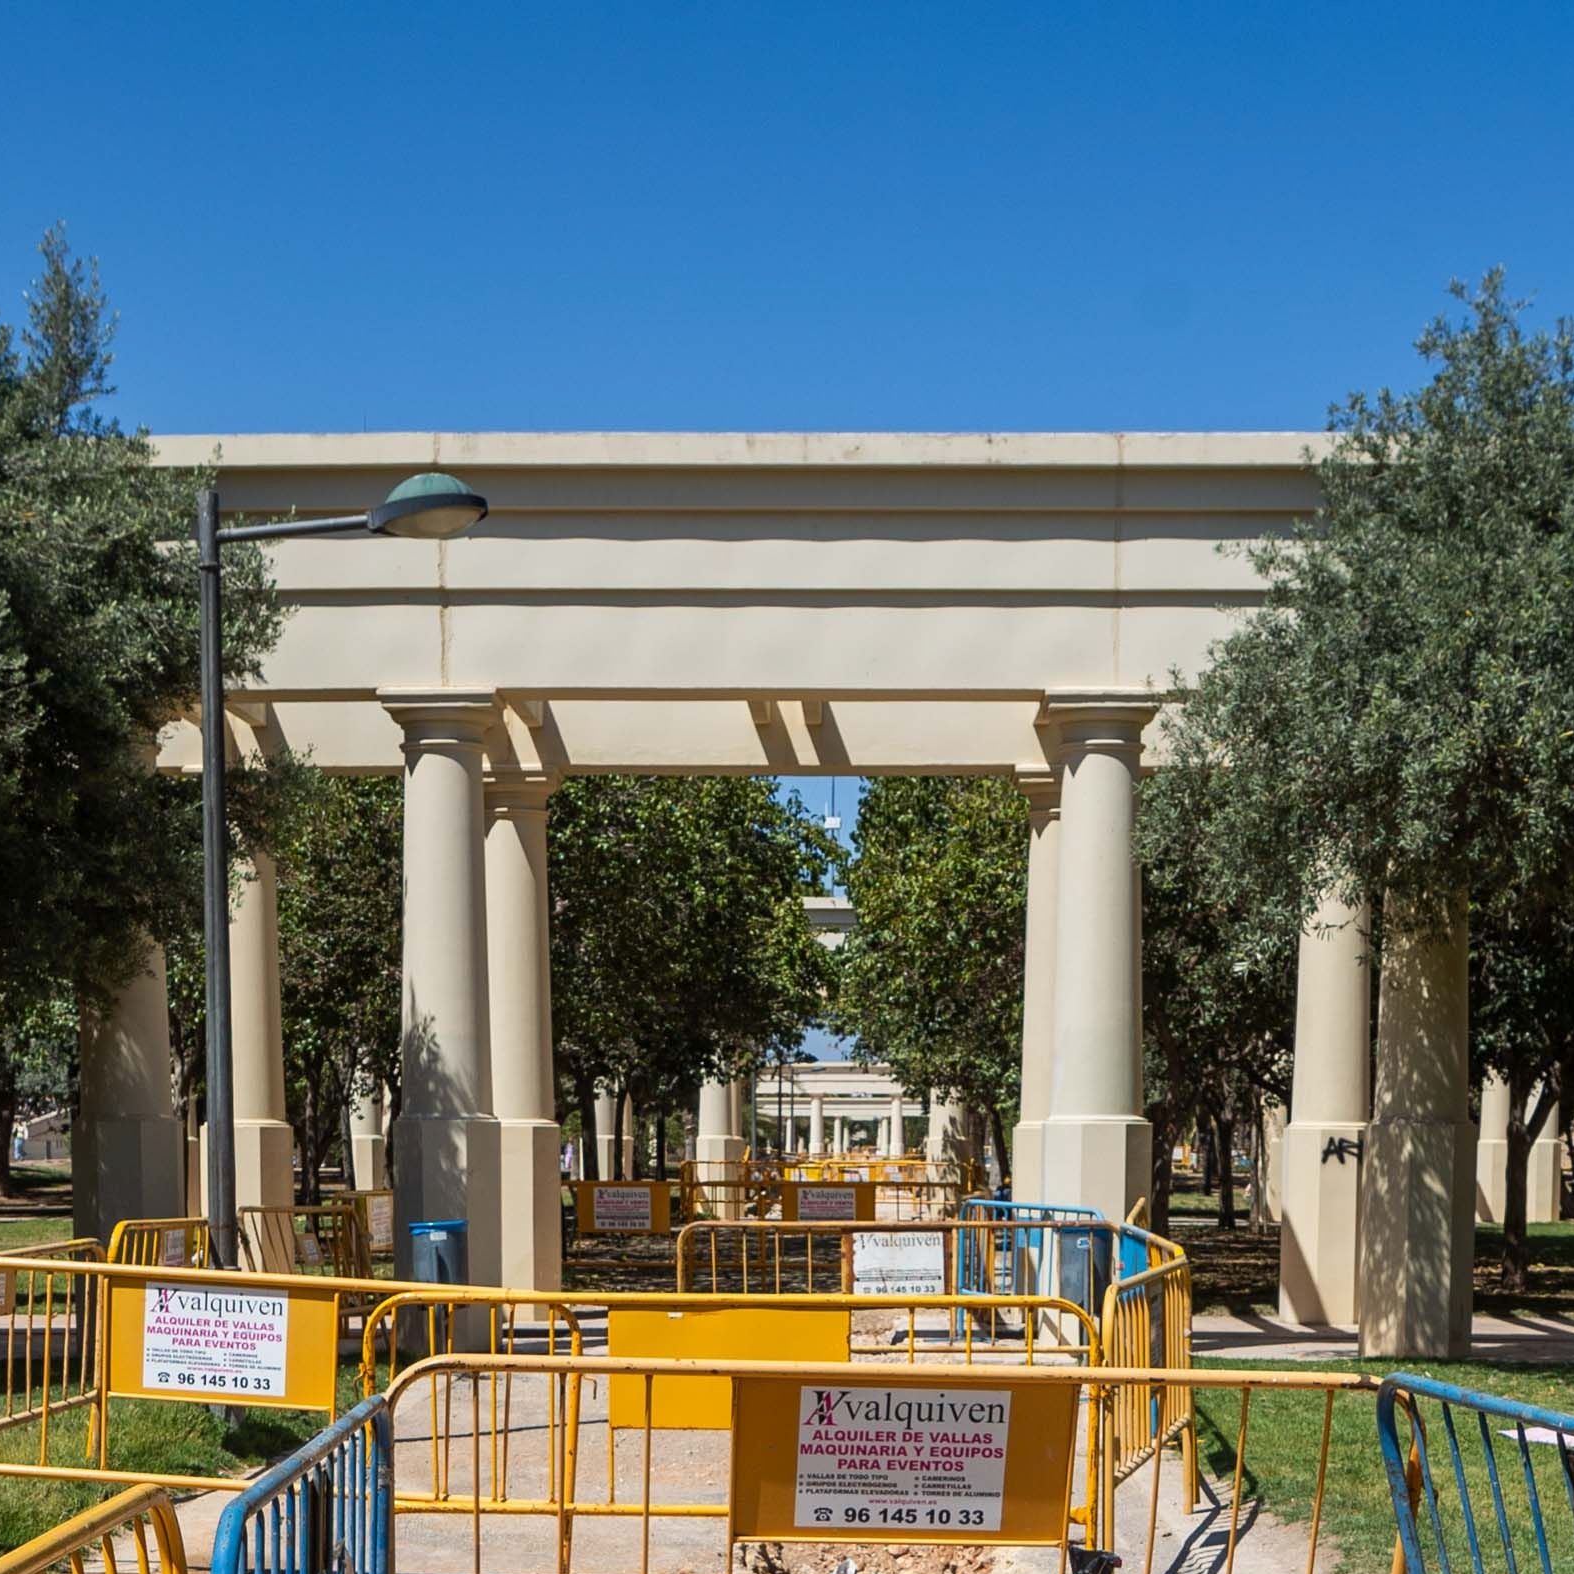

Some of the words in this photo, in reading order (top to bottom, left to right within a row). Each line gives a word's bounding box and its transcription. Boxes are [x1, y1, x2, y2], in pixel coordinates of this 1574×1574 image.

[178, 1291, 283, 1318] valquiven
[155, 1316, 211, 1327] ALQUILER
[215, 1319, 228, 1328] DE
[233, 1321, 274, 1331] VALLAS
[147, 1326, 218, 1338] MAQUINARIA
[233, 1332, 282, 1342] EQUIPOS
[172, 1337, 201, 1347] PARA
[205, 1340, 257, 1350] EVENTOS
[178, 1373, 195, 1384] 96
[201, 1375, 226, 1387] 145
[232, 1376, 248, 1388] 10
[253, 1378, 271, 1390] 33
[844, 1392, 1005, 1430] valquiven
[812, 1430, 896, 1442] ALQUILER
[902, 1431, 923, 1443] DE
[929, 1432, 993, 1444] VALLAS
[800, 1443, 907, 1457] MAQUINARIA
[914, 1446, 925, 1457] Y
[930, 1446, 1004, 1459] EQUIPOS
[838, 1459, 881, 1470] PARA
[887, 1460, 964, 1472] EVENTOS
[844, 1507, 870, 1523] 96
[878, 1508, 917, 1524] 145
[925, 1509, 951, 1525] 10
[958, 1509, 984, 1525] 33
